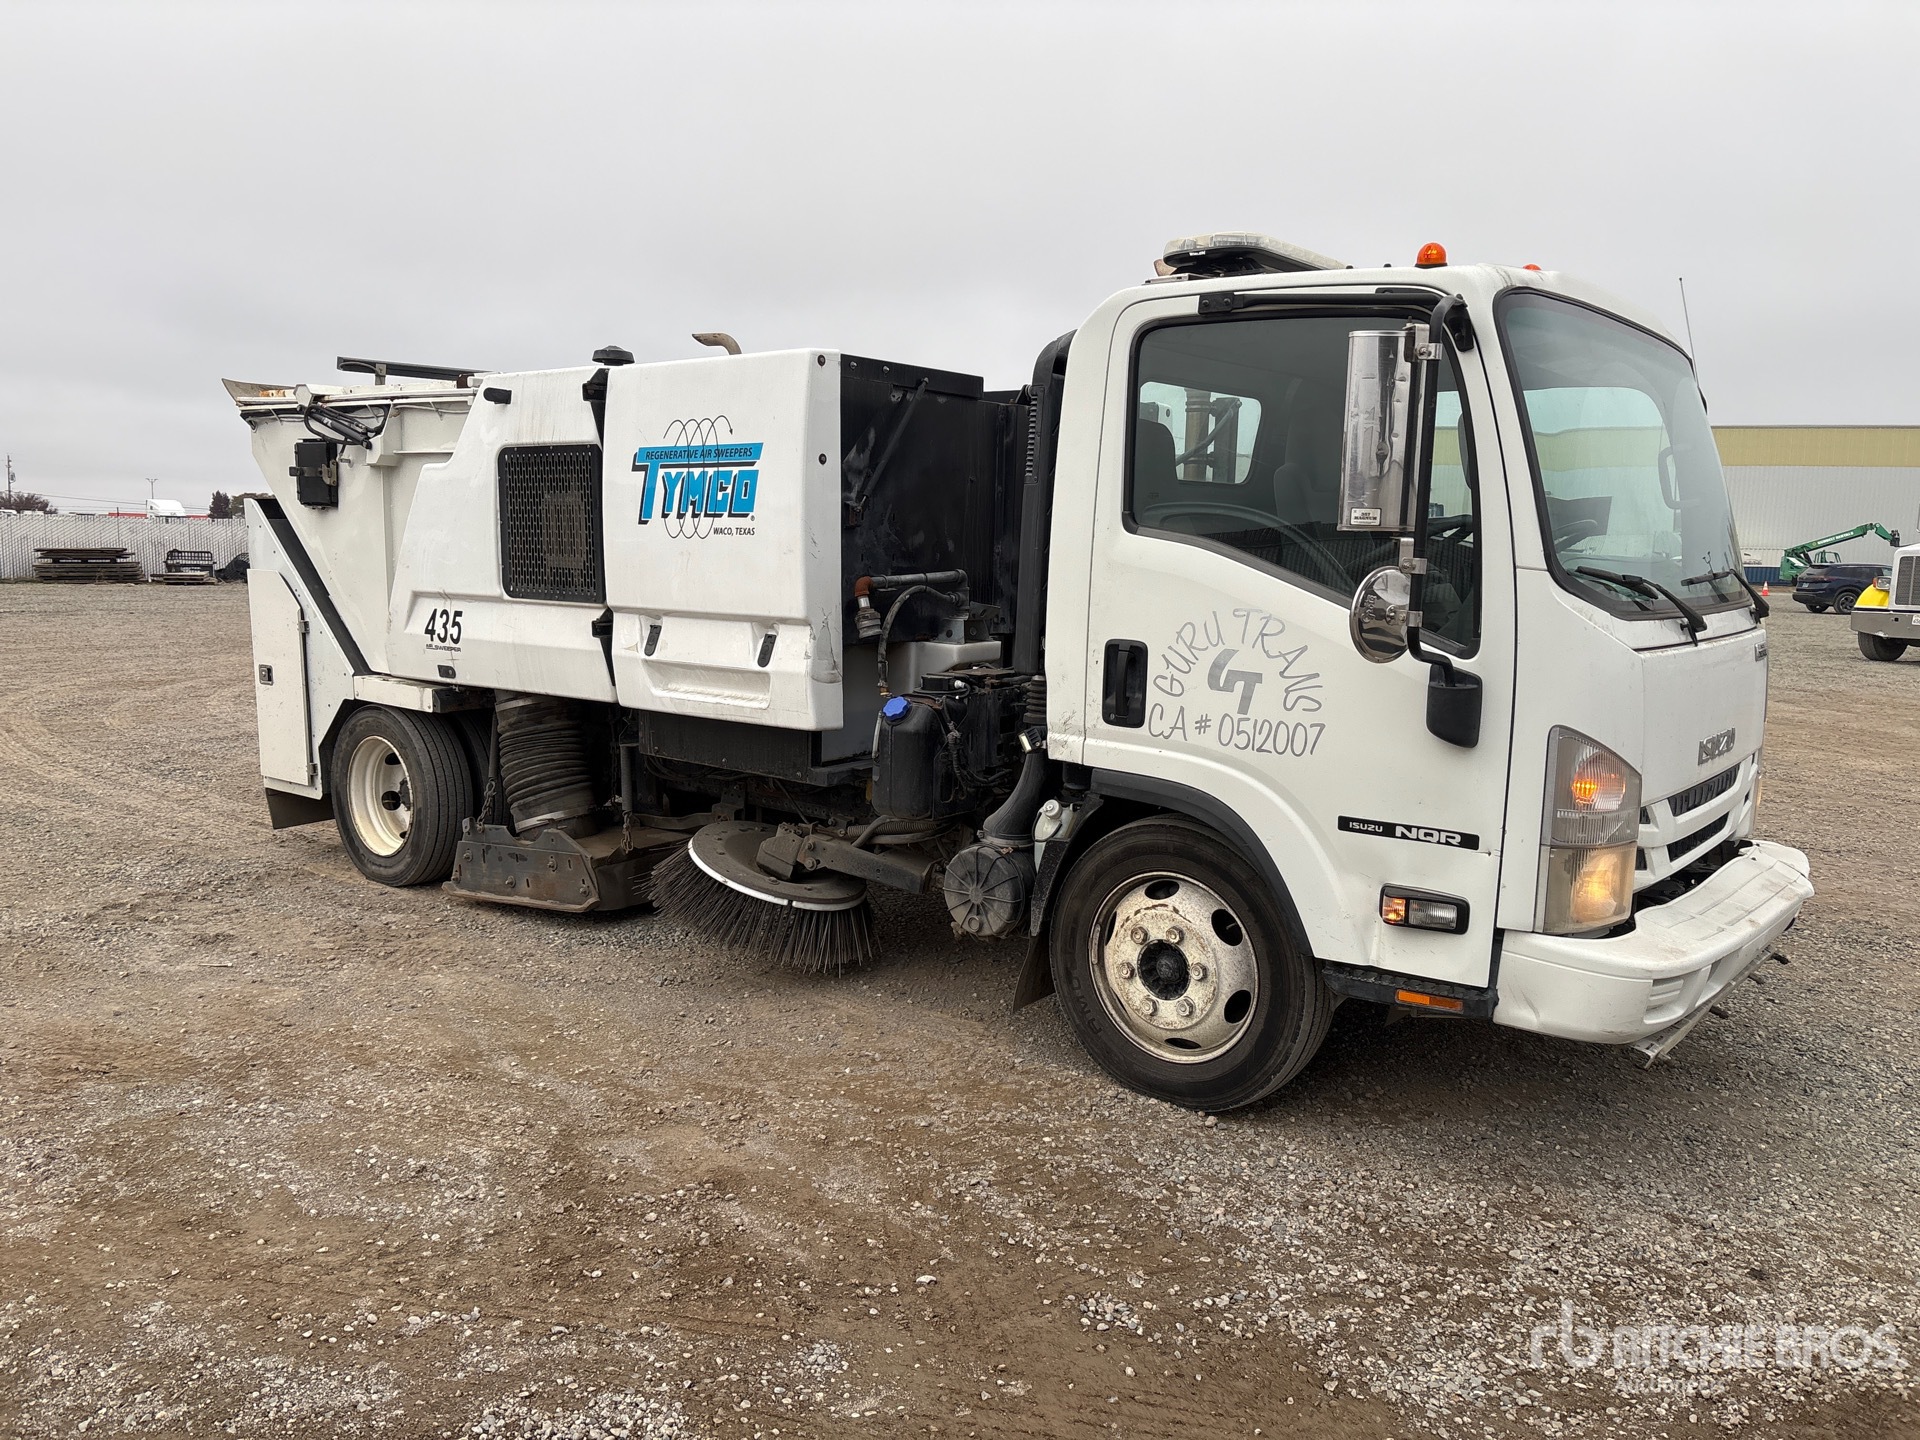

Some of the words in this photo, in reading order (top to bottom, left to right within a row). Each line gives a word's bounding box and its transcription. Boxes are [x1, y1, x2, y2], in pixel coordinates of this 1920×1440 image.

[645, 449, 699, 460] REGENERATIVE
[700, 448, 712, 458] AIR
[713, 447, 753, 458] SWEEPERS
[713, 527, 734, 536] WACO,
[735, 527, 755, 536] TEXAS
[424, 608, 463, 645] 435
[1153, 611, 1225, 698] GURU
[1232, 608, 1324, 712] TRANS
[1349, 821, 1383, 833] ISUZU
[1395, 825, 1461, 846] NQR
